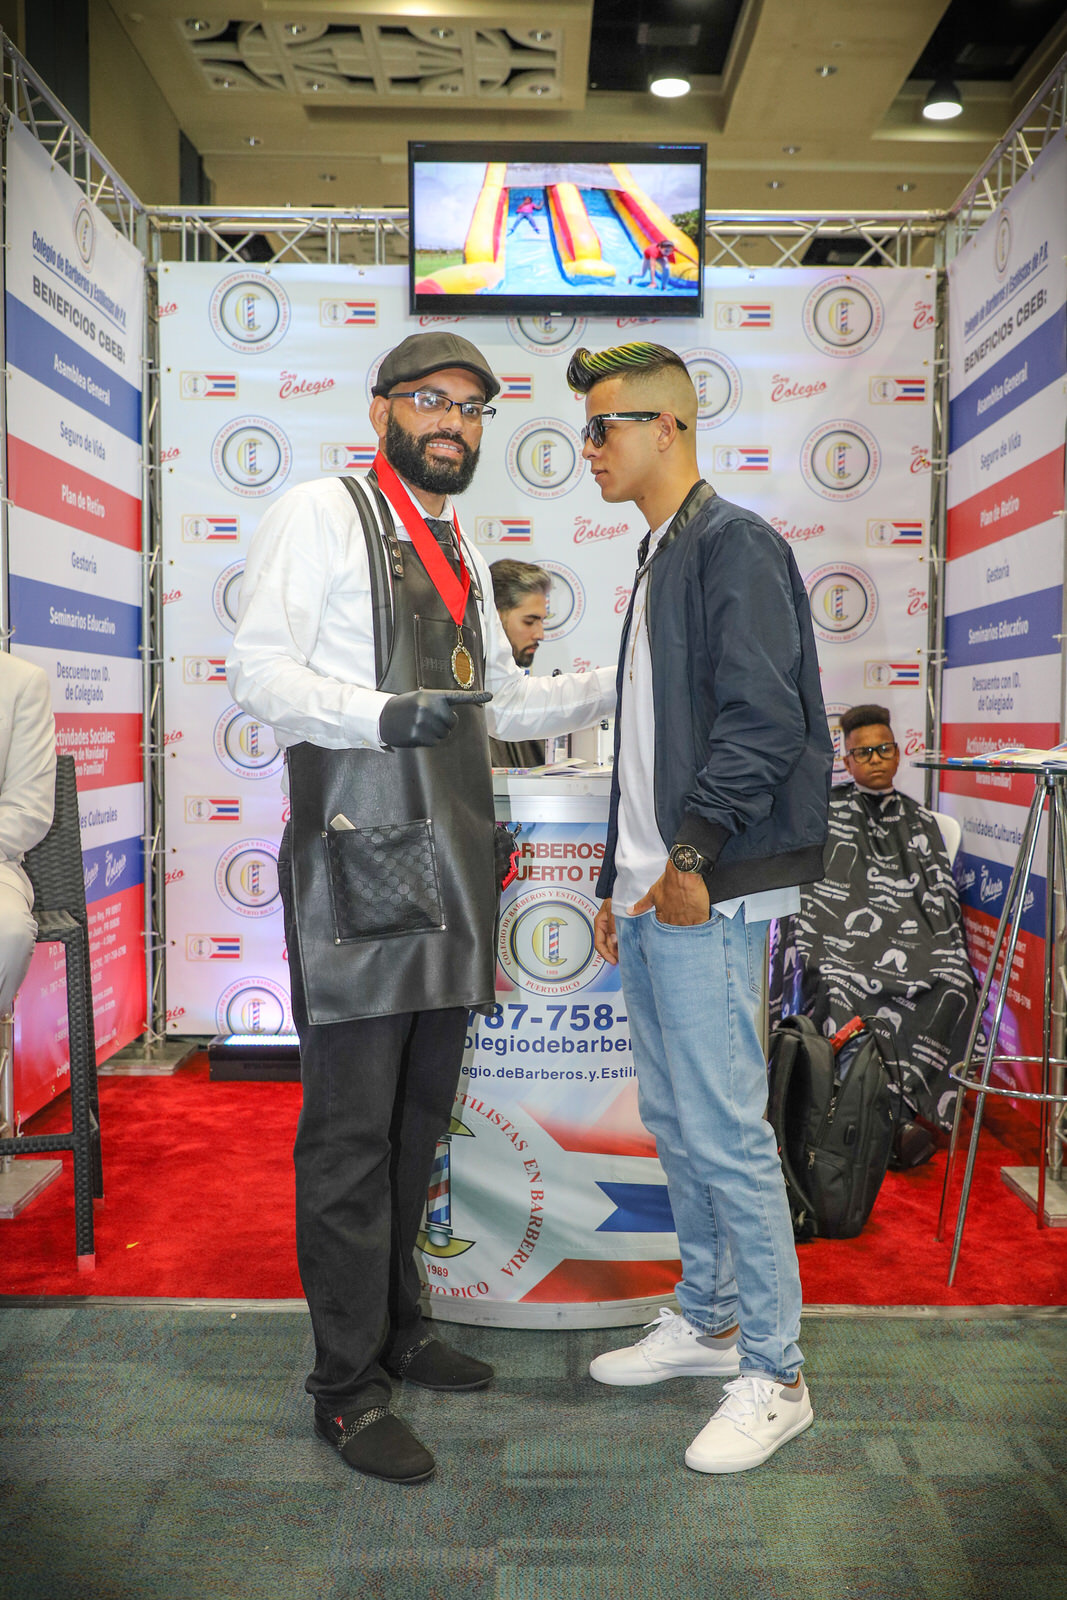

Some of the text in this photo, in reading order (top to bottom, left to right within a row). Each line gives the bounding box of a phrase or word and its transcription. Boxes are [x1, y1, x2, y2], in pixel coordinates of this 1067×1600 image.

[33, 275, 126, 364] BENEFICIOS CBEB:
[964, 289, 1048, 373] BENEFICIOS CBEB:
[53, 353, 111, 407] Asamblea General
[280, 370, 297, 382] Soy
[772, 374, 790, 384] Soy
[279, 376, 336, 400] Colegio
[771, 380, 827, 402] Colegio
[976, 360, 1029, 416] Asamblea General
[60, 420, 106, 461] Seguro de Vida
[1007, 431, 1022, 453] Vida
[61, 484, 105, 519] Plan de Retiro
[980, 495, 1020, 528] Plan de Retiro
[574, 516, 592, 526] Soy
[573, 522, 629, 544] Colegio
[71, 551, 97, 574] Gestoría
[49, 606, 116, 635] Seminarios Educativo
[968, 616, 1029, 645] Seminarios Educativo
[56, 661, 90, 680] Descuento
[90, 668, 101, 681] con
[65, 683, 104, 706] de Colegiado
[972, 675, 1000, 692] Descuento
[1000, 674, 1011, 689] con
[985, 693, 1014, 715] Colegiado
[90, 727, 116, 745] Sociales:
[88, 807, 118, 827] Culturales
[518, 842, 606, 859] RBEROS
[508, 890, 547, 918] BARBEROS
[555, 890, 597, 917] ESTILISTAS
[502, 916, 512, 928] DE
[500, 927, 512, 966] COLEGIO
[525, 980, 581, 994] PUERTO RICO
[466, 1003, 628, 1032] 787-758-
[464, 1033, 633, 1056] olegiodebarber
[461, 1065, 637, 1082] egio.deBarberos.y.Estili
[453, 1092, 545, 1278] STILISTAS EN BARBERIA
[426, 1263, 449, 1278] 1989
[451, 1281, 489, 1298] RICO
